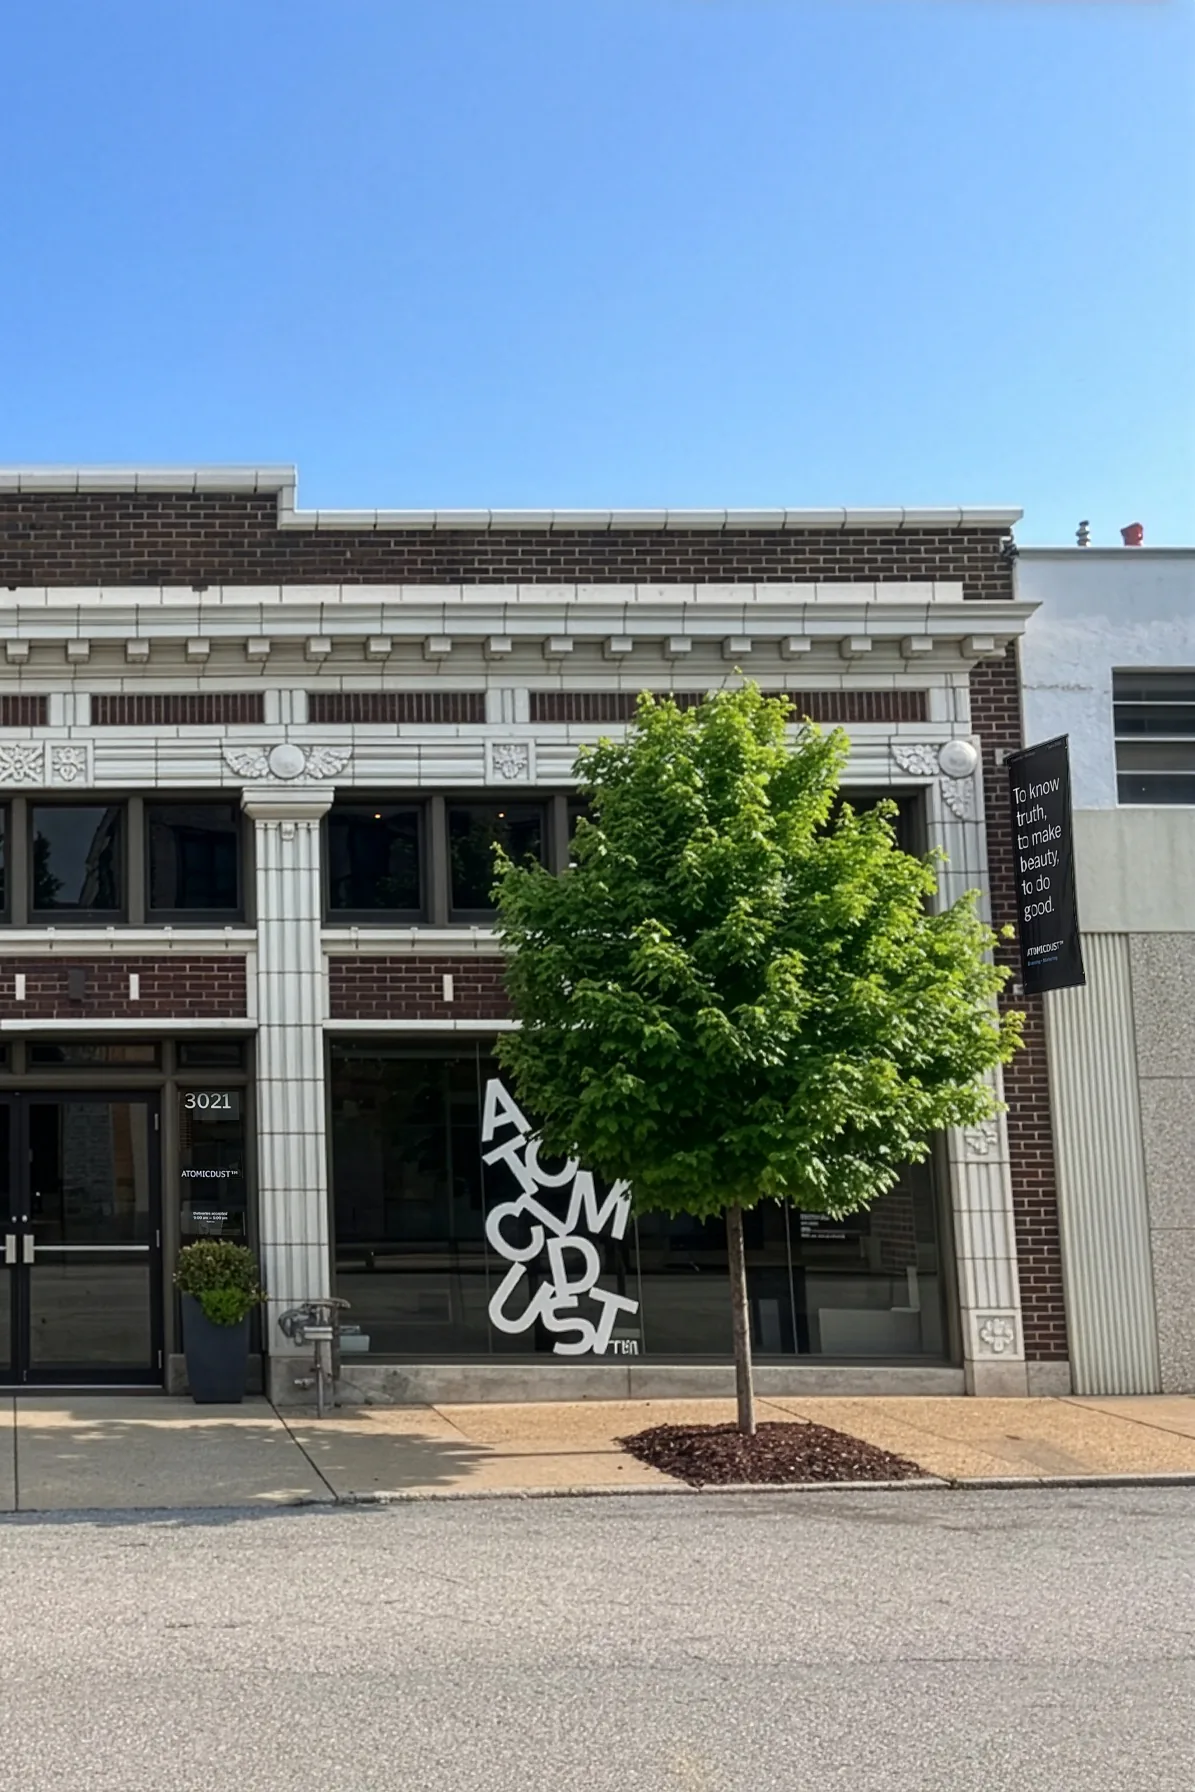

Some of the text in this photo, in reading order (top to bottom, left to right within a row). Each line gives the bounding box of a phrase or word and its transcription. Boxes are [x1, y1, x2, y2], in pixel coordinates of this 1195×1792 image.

[1013, 777, 1060, 804] To know
[1016, 804, 1047, 827] truth,
[1017, 823, 1061, 850] to make
[1020, 849, 1060, 873] beauty,
[1021, 874, 1051, 895] to do
[1024, 895, 1055, 922] good.
[184, 1092, 232, 1109] 3021
